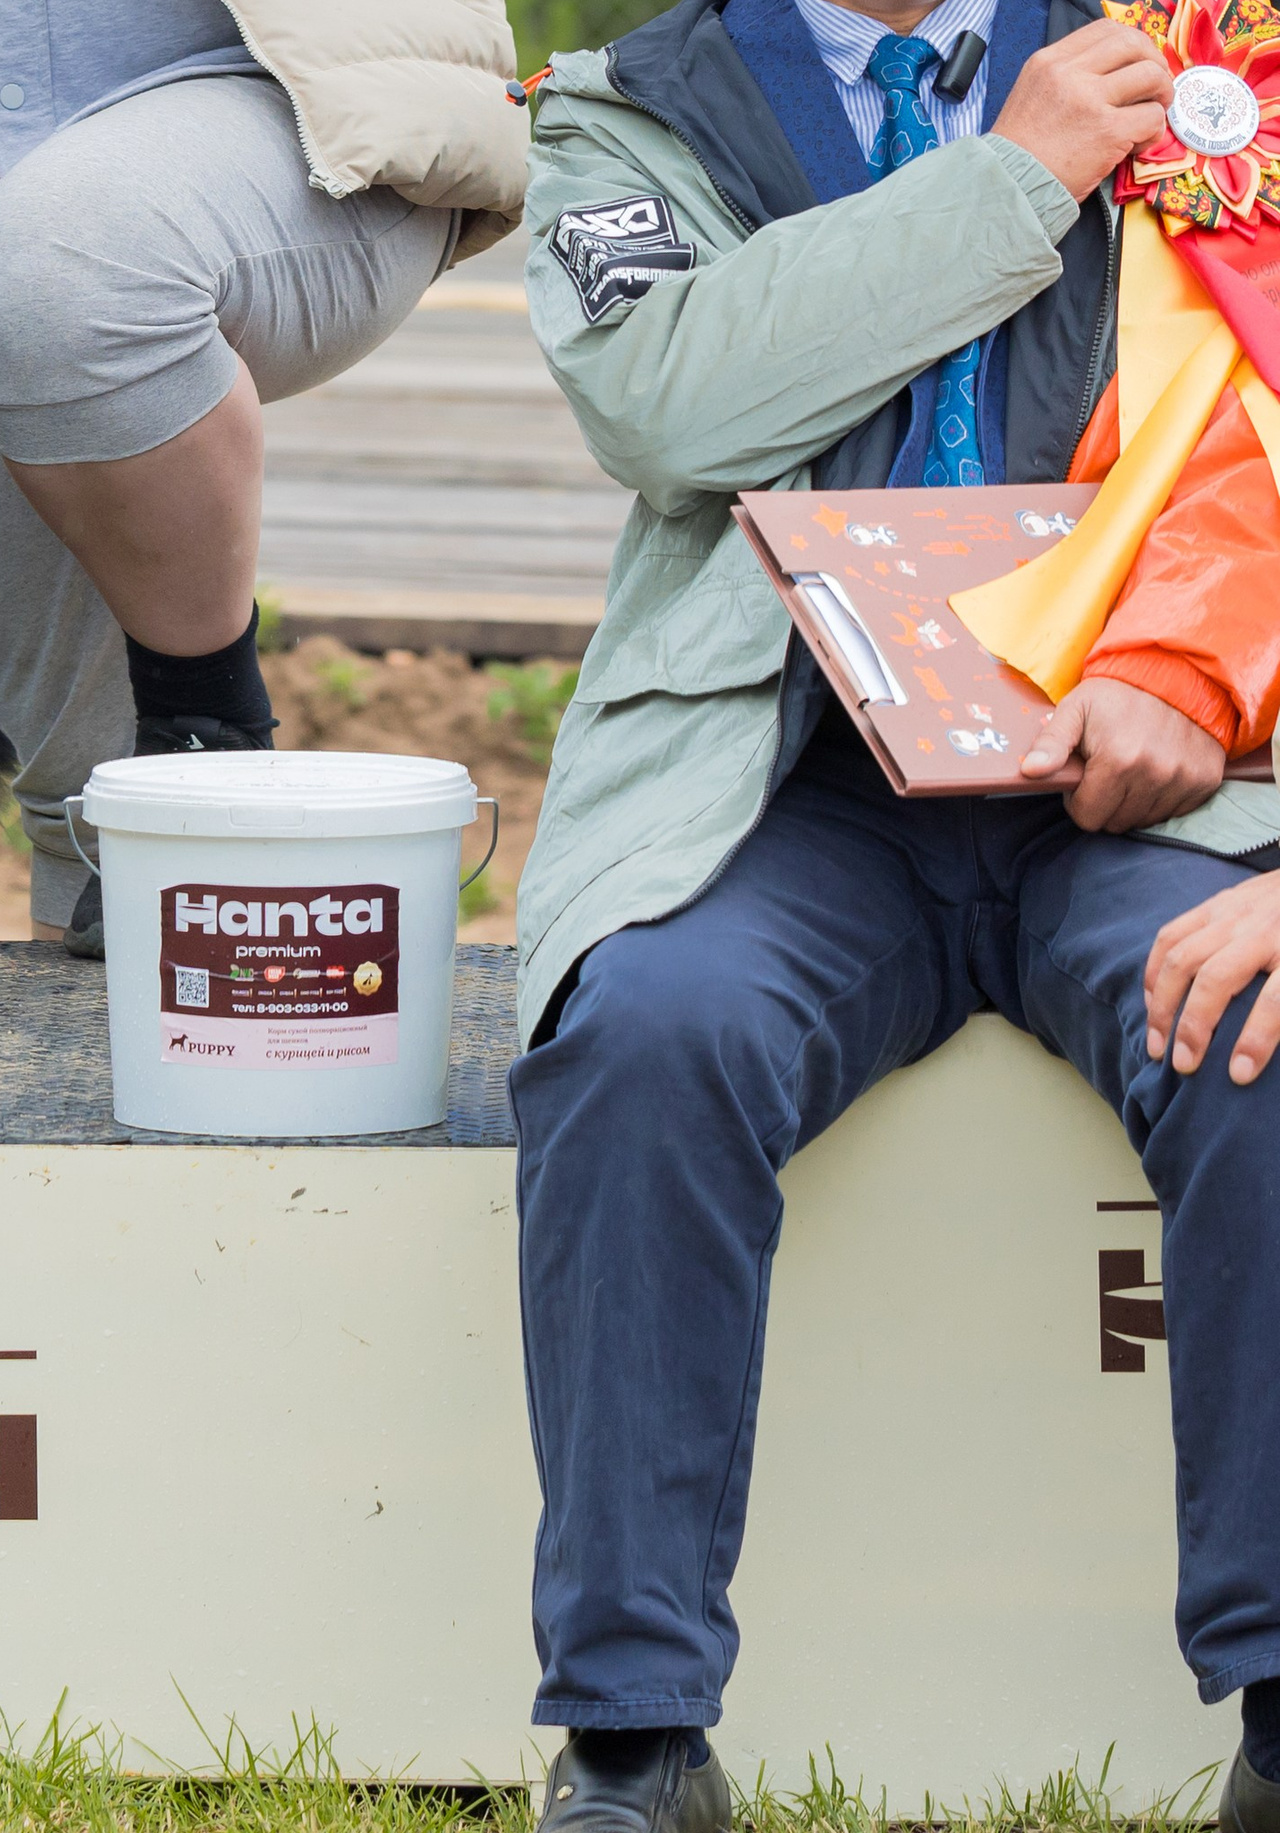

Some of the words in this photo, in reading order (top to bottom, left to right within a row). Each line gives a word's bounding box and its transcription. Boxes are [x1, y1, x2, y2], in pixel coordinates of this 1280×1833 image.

[175, 892, 383, 937] Hanta
[235, 944, 321, 959] premium
[188, 1043, 235, 1057] PUPPY
[266, 1049, 272, 1058] с
[274, 1046, 324, 1060] курицей
[327, 1048, 334, 1057] и
[336, 1046, 370, 1059] рисом
